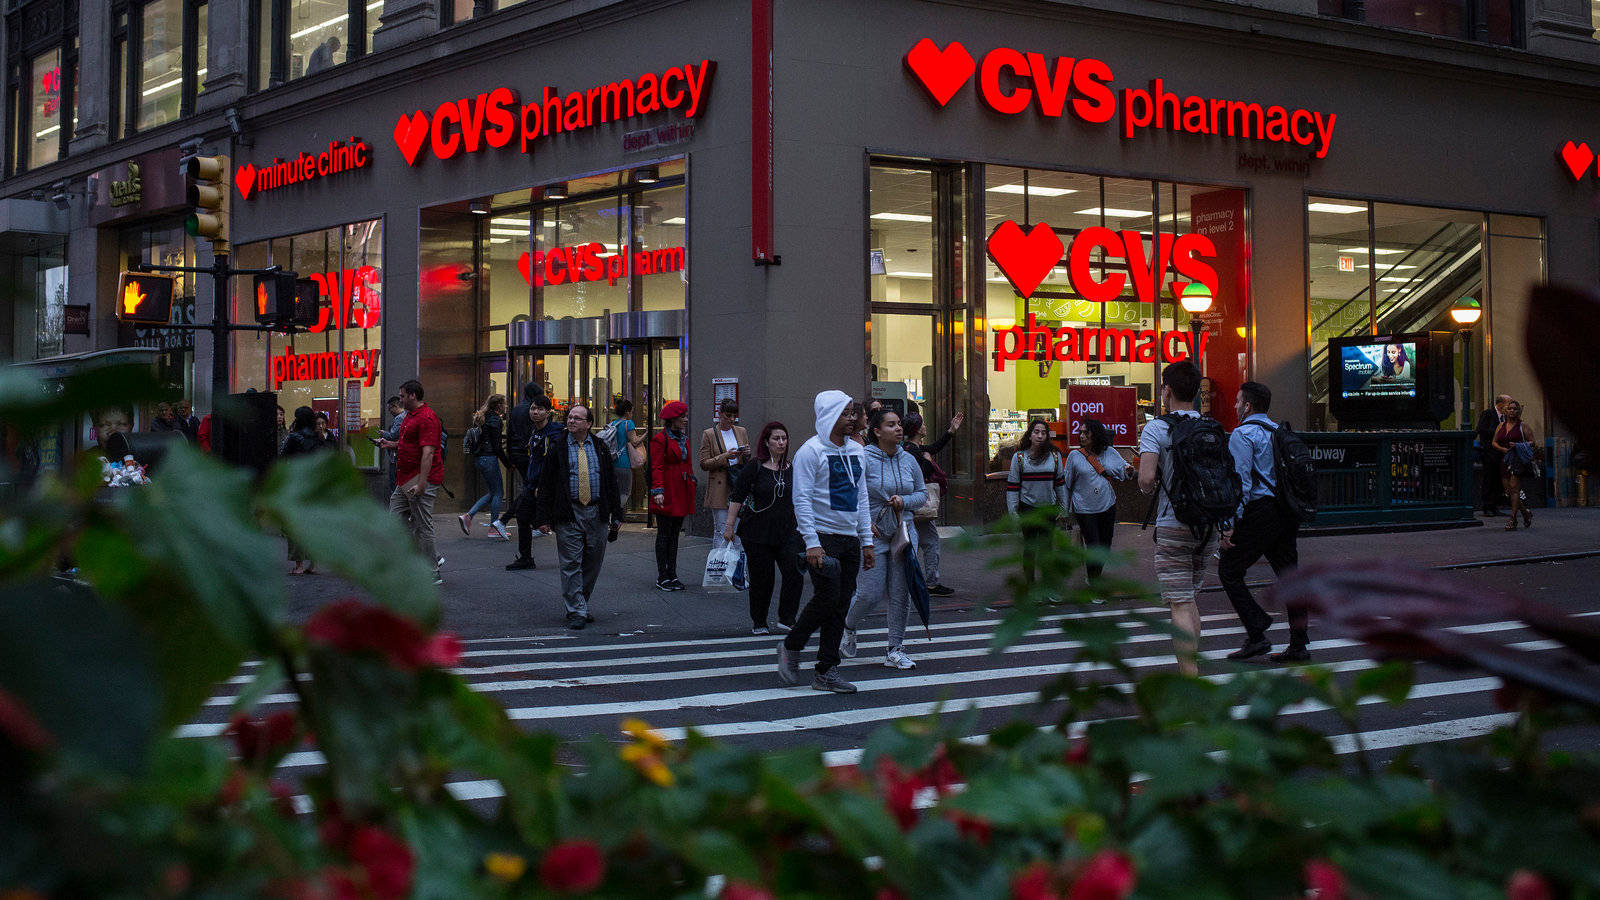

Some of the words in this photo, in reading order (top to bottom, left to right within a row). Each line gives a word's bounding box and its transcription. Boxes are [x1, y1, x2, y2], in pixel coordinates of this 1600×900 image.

[430, 87, 514, 160] CVS
[521, 59, 709, 153] pharmacy
[980, 47, 1116, 123] CVS
[1126, 78, 1337, 159] pharmacy
[623, 131, 653, 150] dept.
[656, 123, 694, 143] within
[257, 152, 315, 192] minute
[318, 136, 366, 176] clinic
[1238, 153, 1271, 172] dept.
[1274, 158, 1310, 174] within
[1196, 208, 1235, 225] pharmacy
[1197, 226, 1208, 235] on
[1209, 222, 1227, 234] level
[1227, 220, 1235, 232] 2
[545, 242, 604, 285] CVS
[1068, 226, 1219, 303] CVS
[1340, 257, 1353, 270] EXIT
[274, 345, 379, 391] pharmacy
[1344, 363, 1373, 372] Spectrum
[1071, 402, 1104, 417] open
[1071, 420, 1080, 435] 2
[1103, 423, 1127, 435] urs
[1308, 445, 1344, 464] ubway
